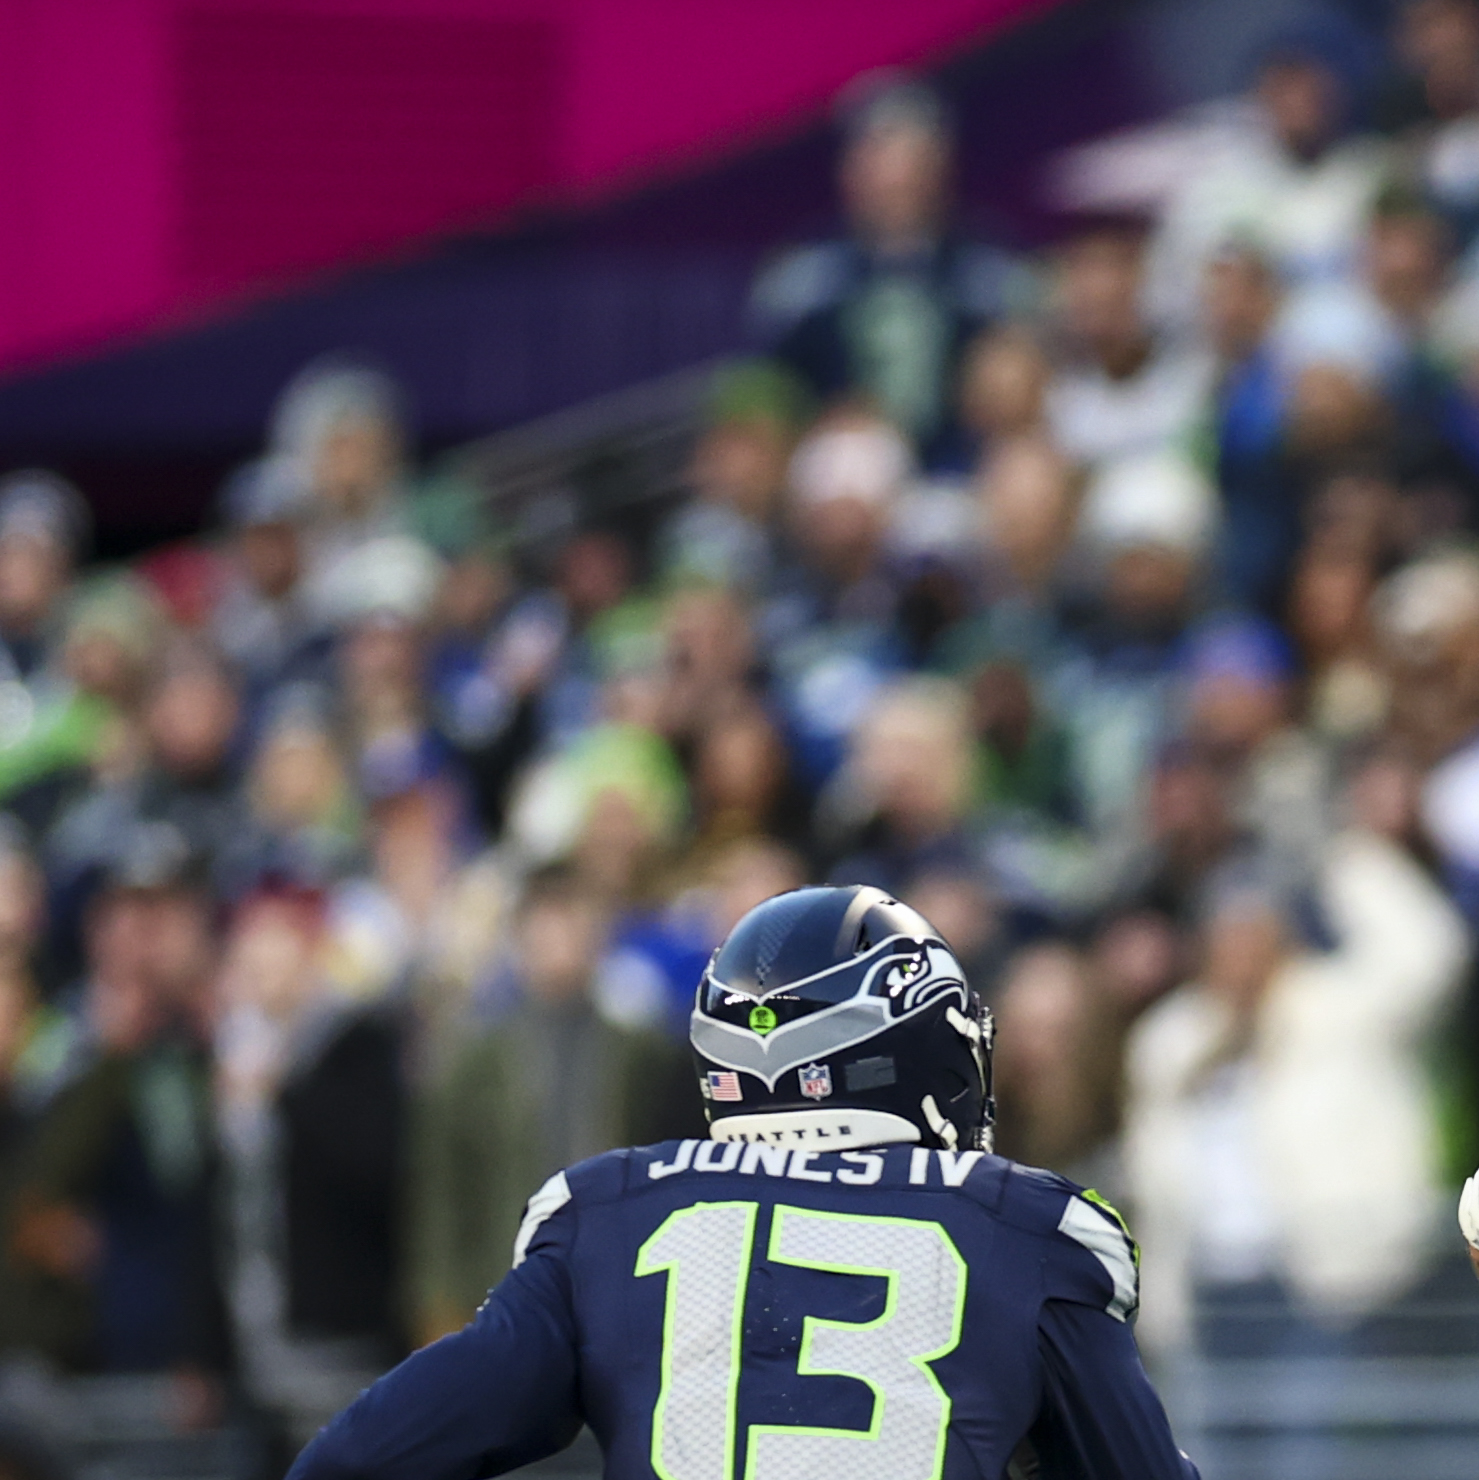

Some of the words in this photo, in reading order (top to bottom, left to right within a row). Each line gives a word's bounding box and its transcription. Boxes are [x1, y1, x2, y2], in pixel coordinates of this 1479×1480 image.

[727, 1125, 852, 1143] SEATTLE
[648, 1139, 888, 1185] JONES
[909, 1146, 985, 1187] IV
